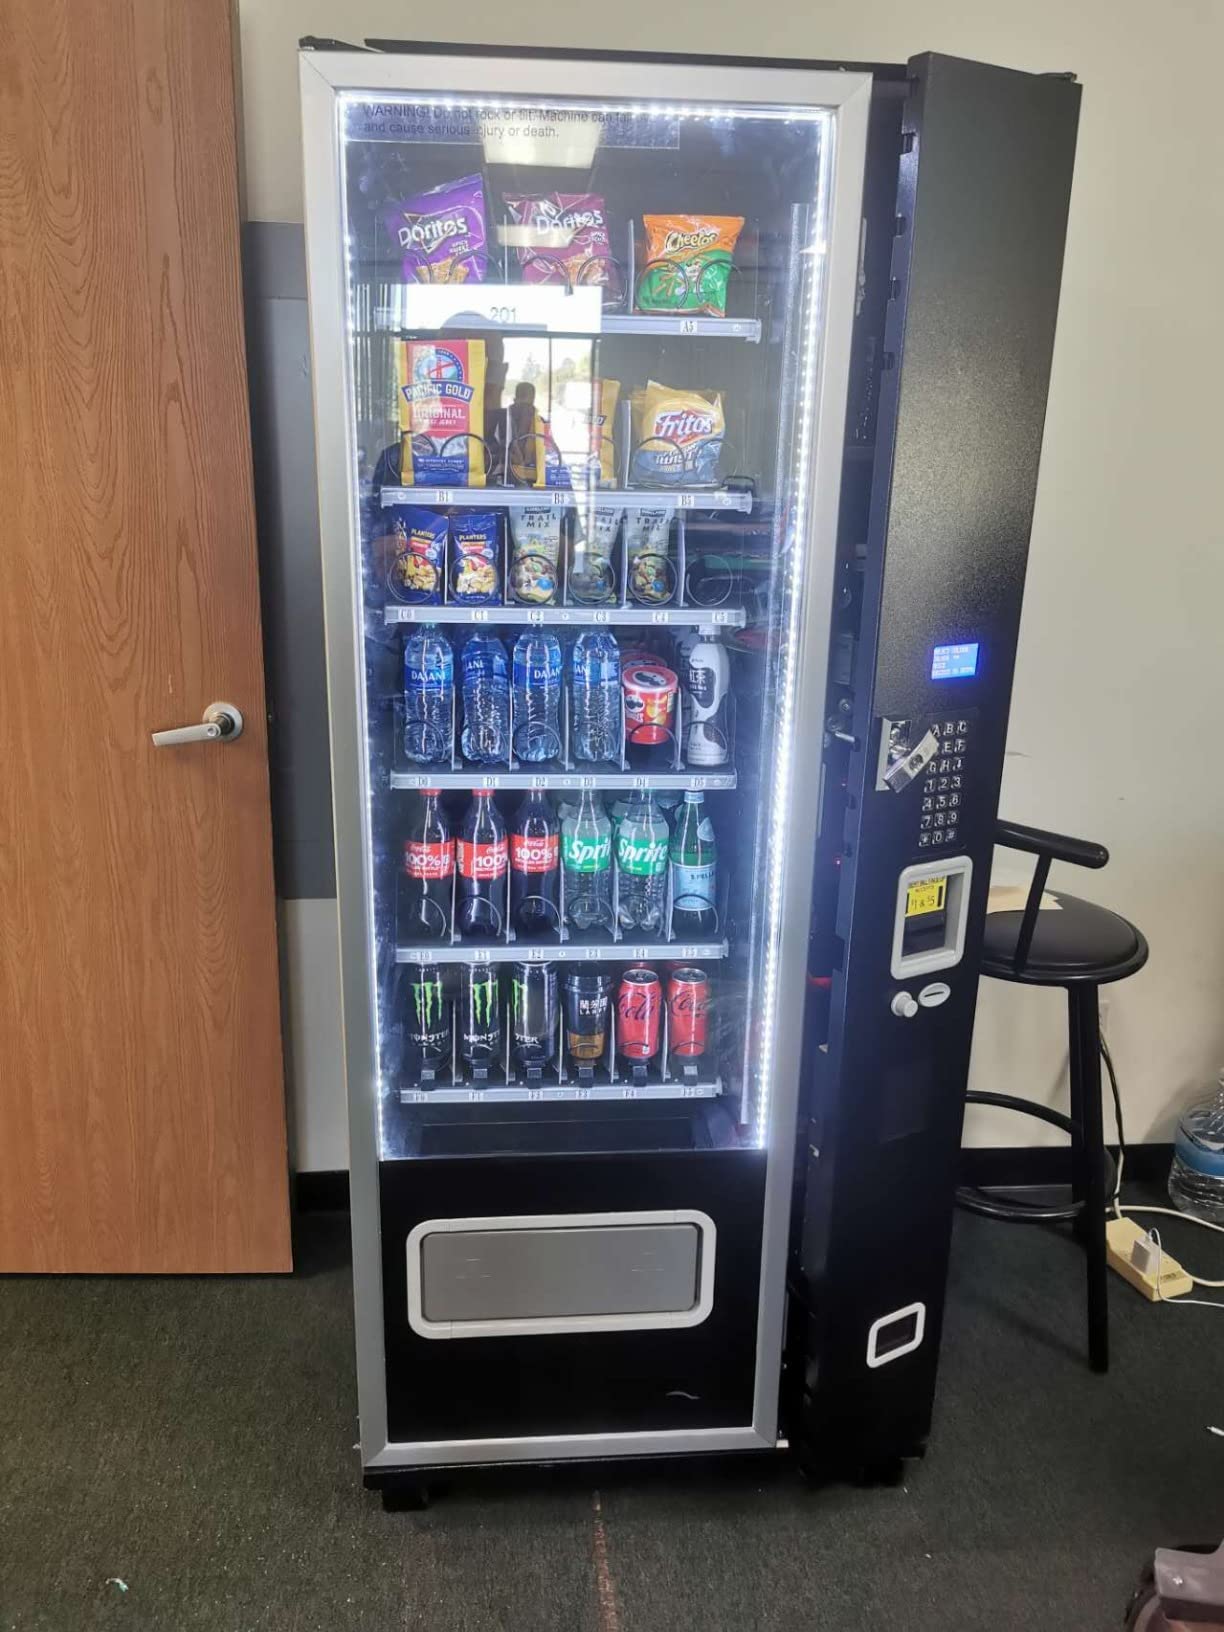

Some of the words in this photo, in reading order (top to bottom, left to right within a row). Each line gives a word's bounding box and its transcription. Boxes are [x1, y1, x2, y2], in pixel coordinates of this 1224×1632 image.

[363, 103, 430, 119] WARNING!
[364, 122, 385, 133] and
[389, 124, 424, 134] cause
[428, 124, 470, 135] serious
[508, 128, 520, 136] or
[398, 217, 468, 249] Doritos
[665, 230, 720, 253] Cheetos
[489, 306, 517, 323] 201
[405, 384, 443, 399] PACIFIC
[445, 383, 472, 399] GOLD
[654, 413, 714, 437] Fritos
[932, 724, 940, 737] A
[946, 723, 954, 734] B
[959, 721, 967, 732] C
[944, 742, 952, 752] E
[516, 846, 552, 861] 100%
